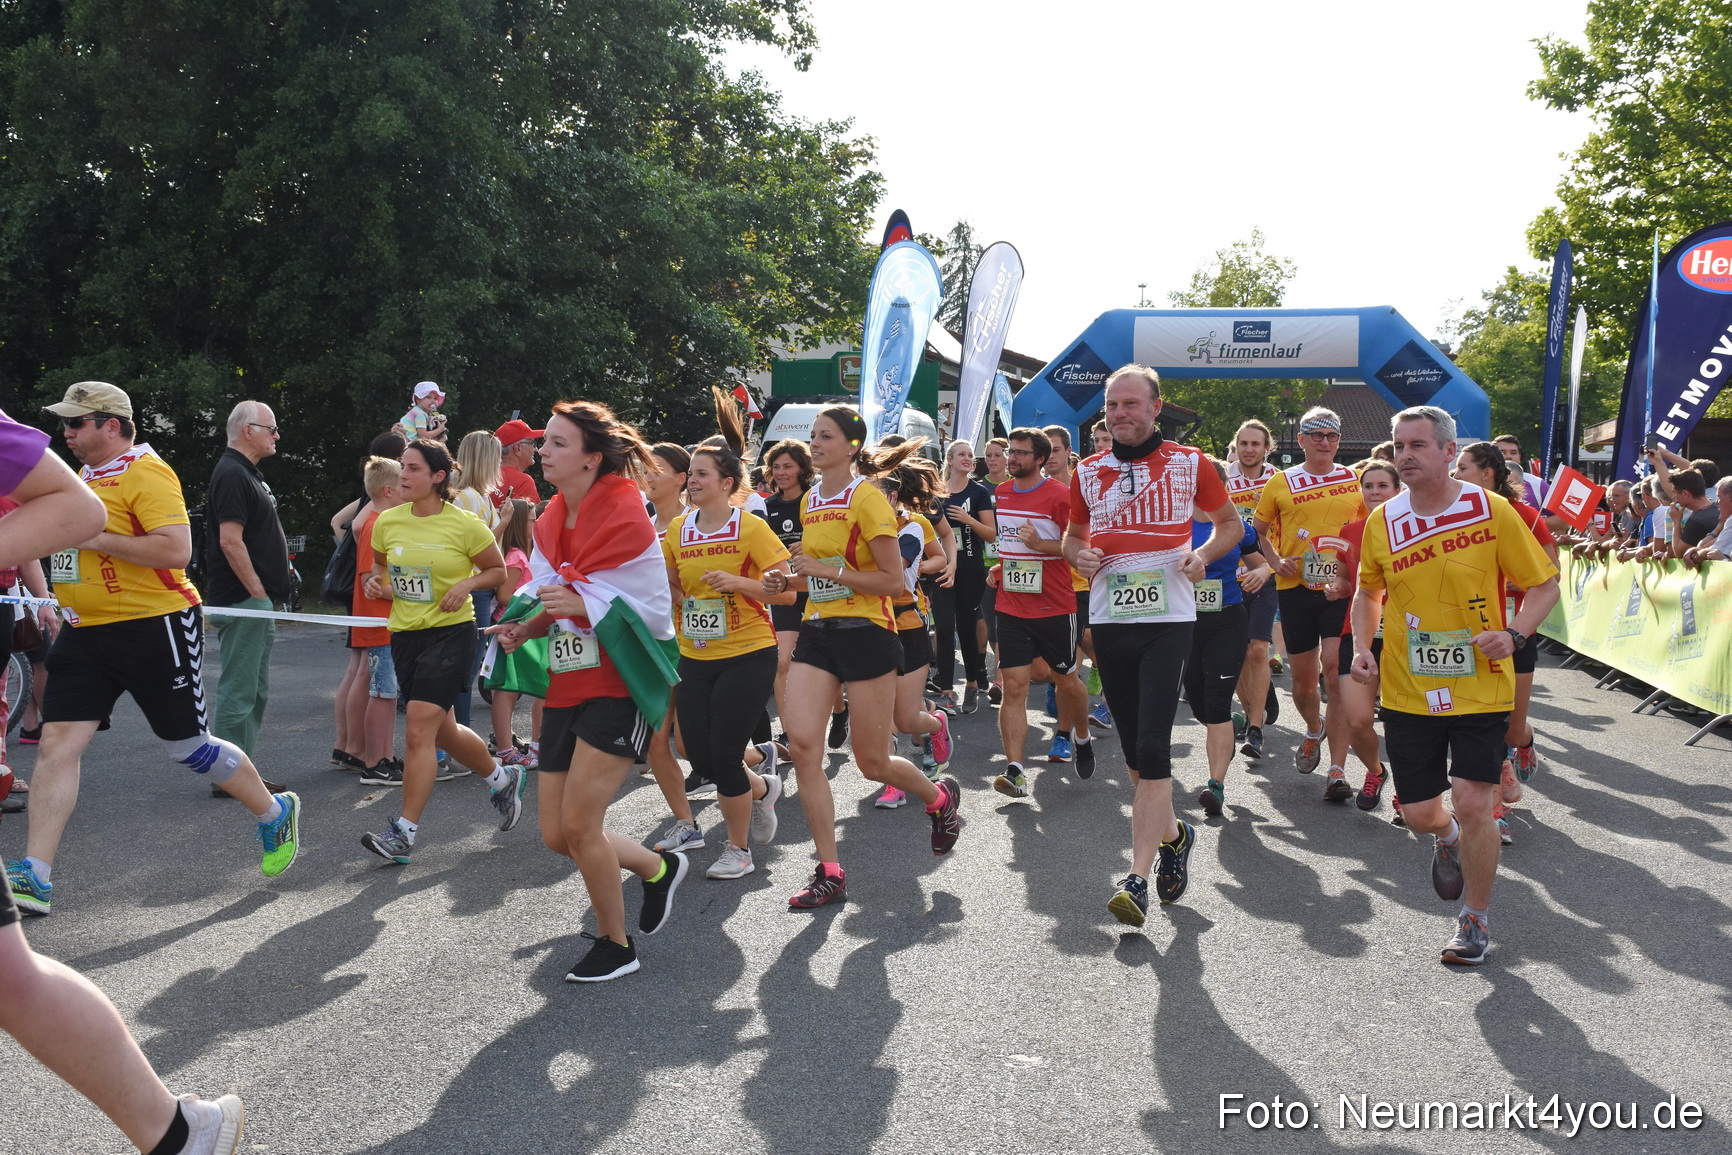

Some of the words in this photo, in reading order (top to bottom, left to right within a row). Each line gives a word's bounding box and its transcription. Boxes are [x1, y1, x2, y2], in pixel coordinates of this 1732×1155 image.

[1690, 249, 1732, 276] He
[1242, 328, 1269, 336] Fischer
[1219, 343, 1303, 359] firmenlauf
[1062, 370, 1106, 380] Fischer
[775, 423, 809, 431] abavent
[1292, 492, 1325, 506] MAX
[823, 510, 849, 523] BÖGL
[680, 550, 704, 560] MAX
[707, 544, 741, 556] BÖGL
[1391, 544, 1438, 575] MAX
[1441, 527, 1497, 558] BÖGL
[393, 577, 425, 593] 1311
[1007, 571, 1037, 584] 1817
[1113, 586, 1160, 606] 2206
[685, 612, 720, 630] 1562
[555, 637, 584, 660] 516
[1415, 647, 1466, 666] 1676
